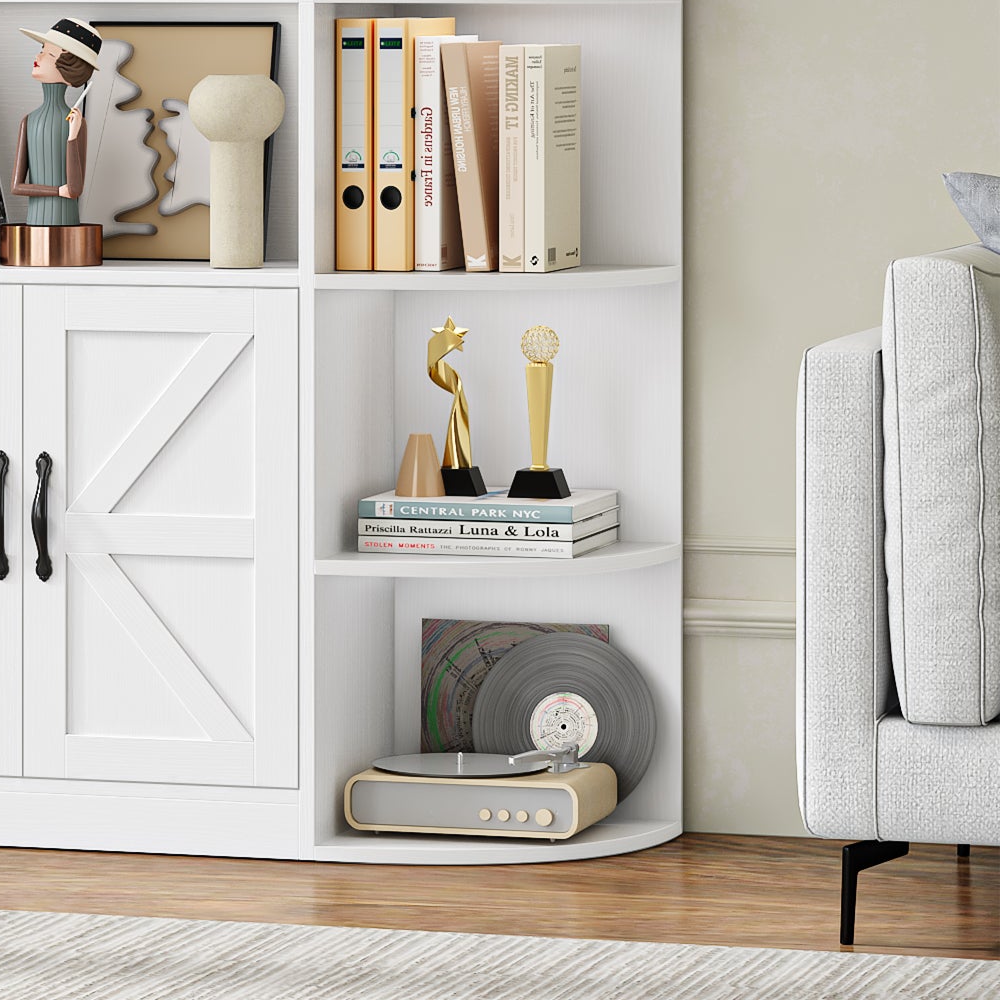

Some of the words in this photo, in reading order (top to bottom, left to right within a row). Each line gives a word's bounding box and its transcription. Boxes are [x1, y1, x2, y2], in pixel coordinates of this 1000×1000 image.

[400, 505, 464, 517] CENTRAL
[471, 507, 506, 518] PARK
[512, 508, 541, 519] NYC
[365, 523, 406, 534] Priscilla
[410, 524, 452, 535] Rattazzi
[459, 524, 498, 536] Luna
[504, 525, 518, 537] &
[524, 525, 560, 538] Lola
